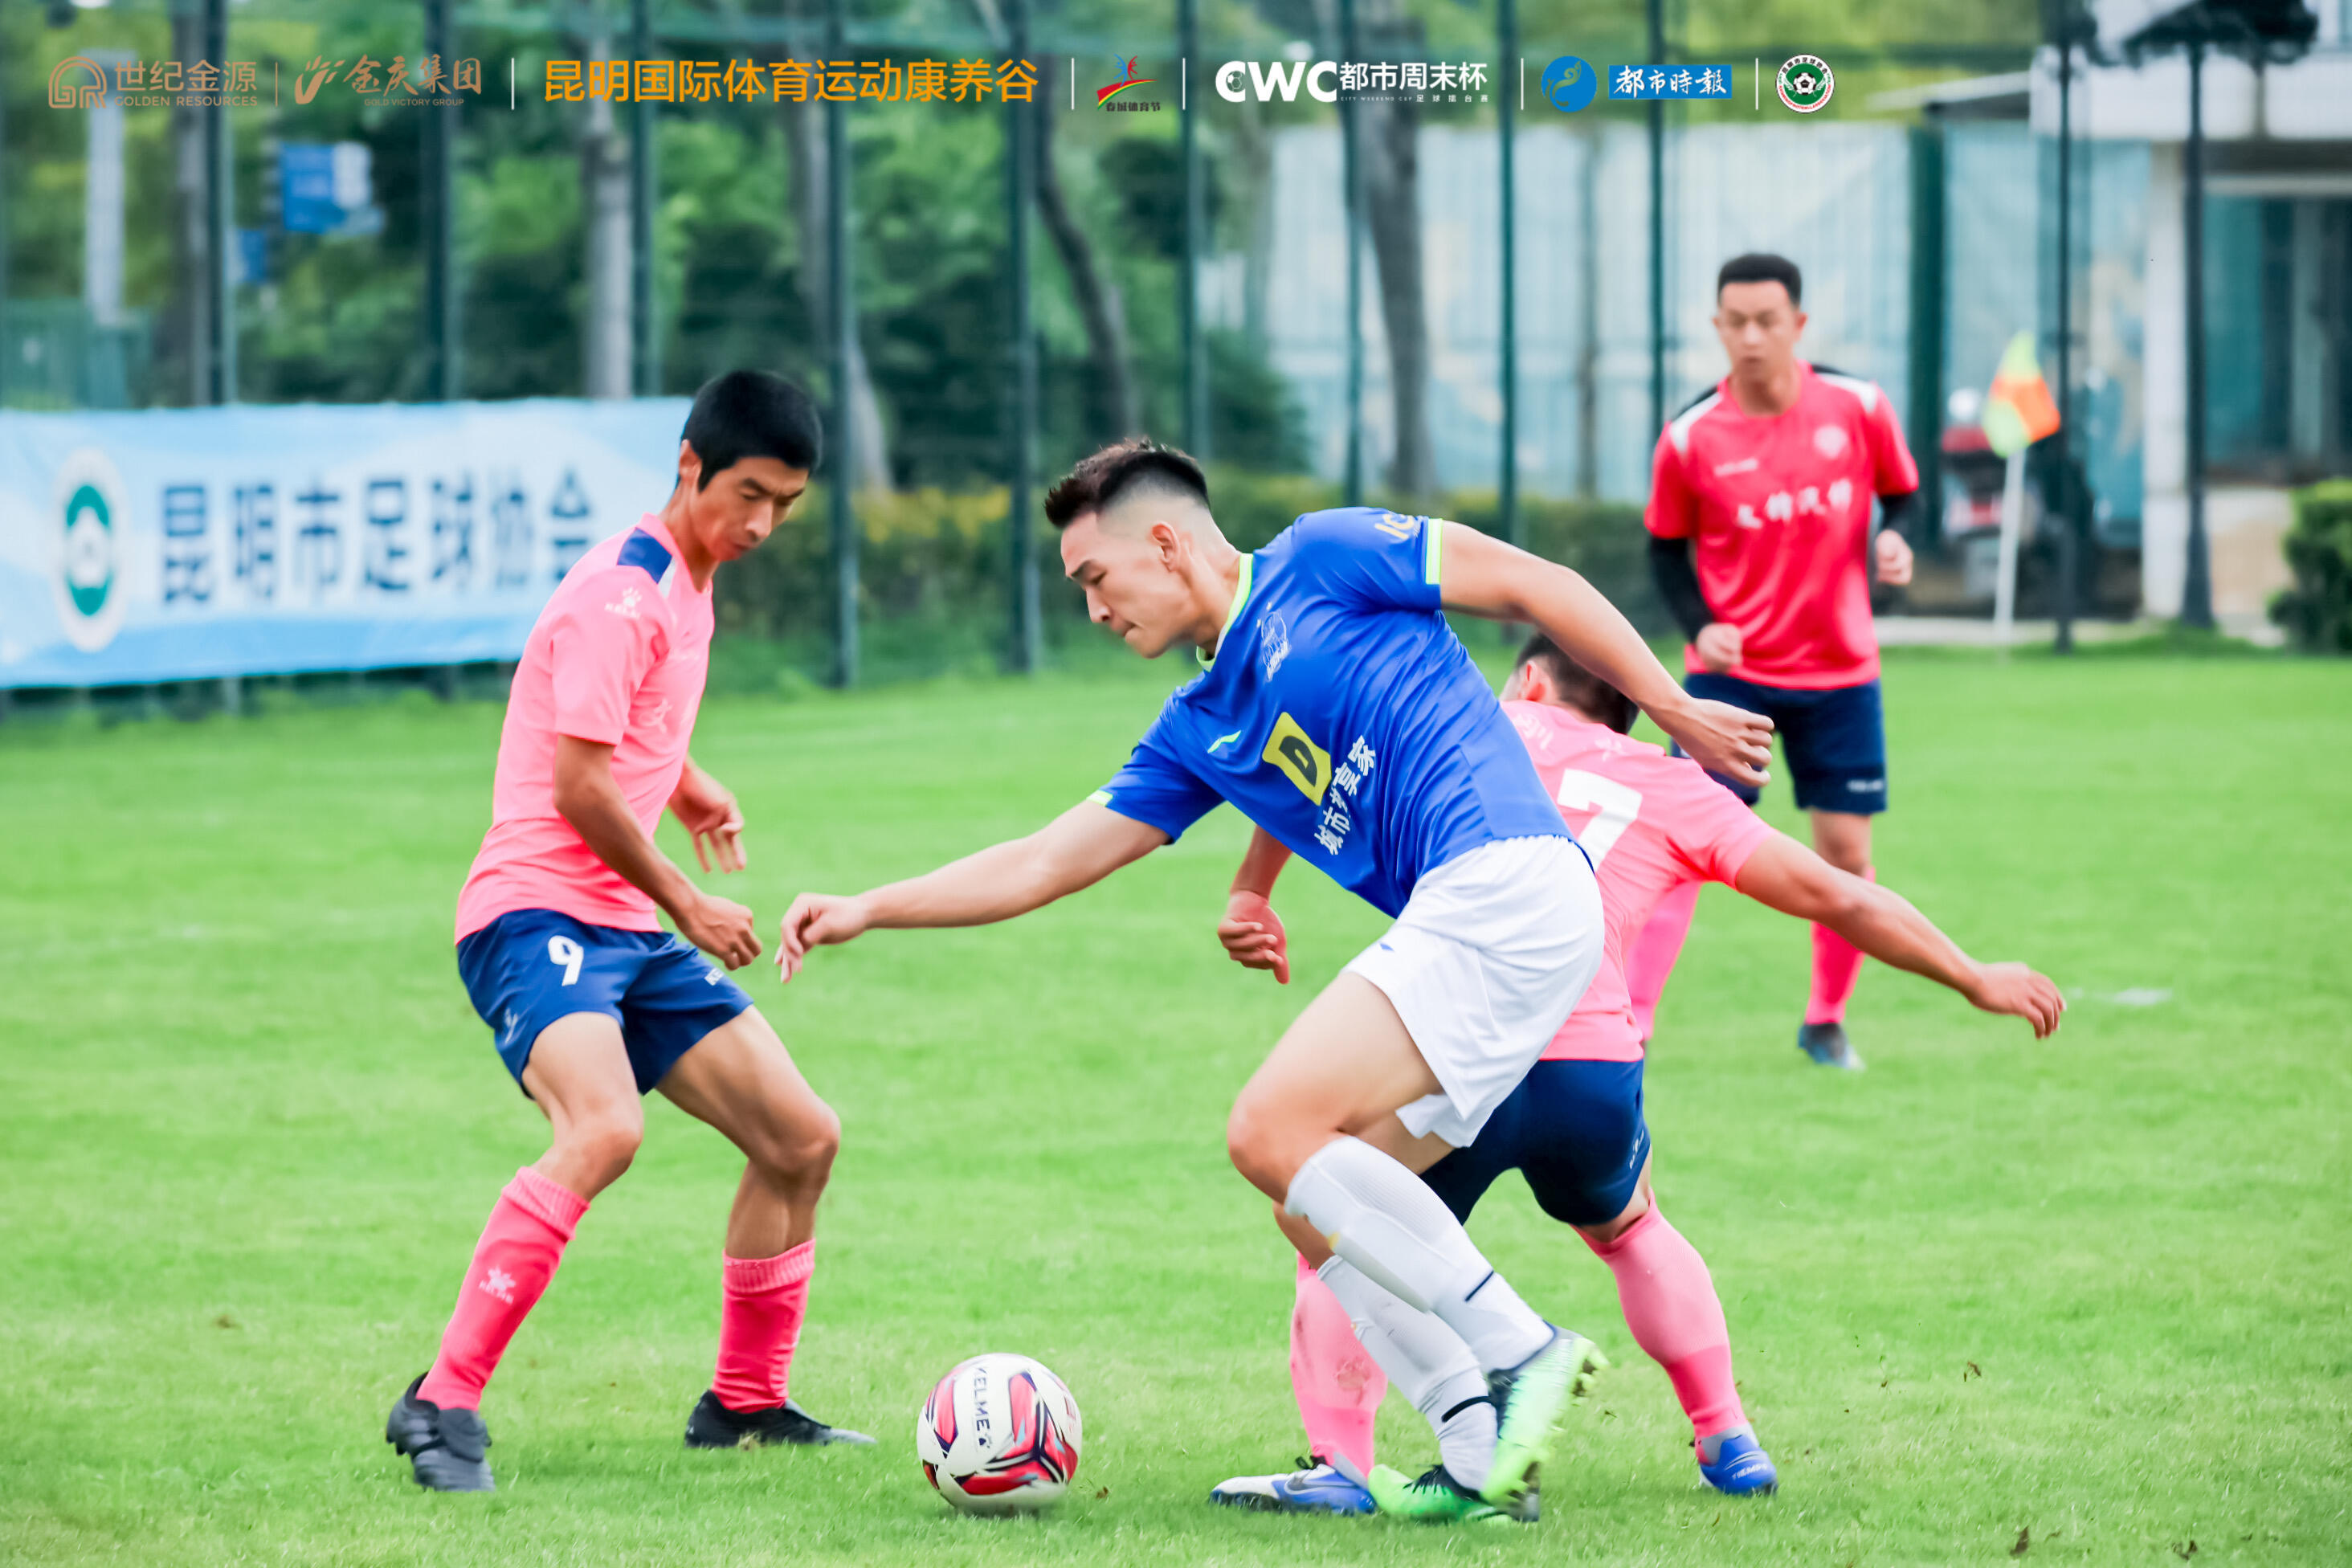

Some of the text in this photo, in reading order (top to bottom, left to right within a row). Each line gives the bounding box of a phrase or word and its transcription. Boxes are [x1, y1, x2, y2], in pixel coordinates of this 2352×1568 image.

[163, 468, 590, 604] 昆明市足球协会
[1557, 768, 1643, 873] 7
[547, 935, 584, 986] 9
